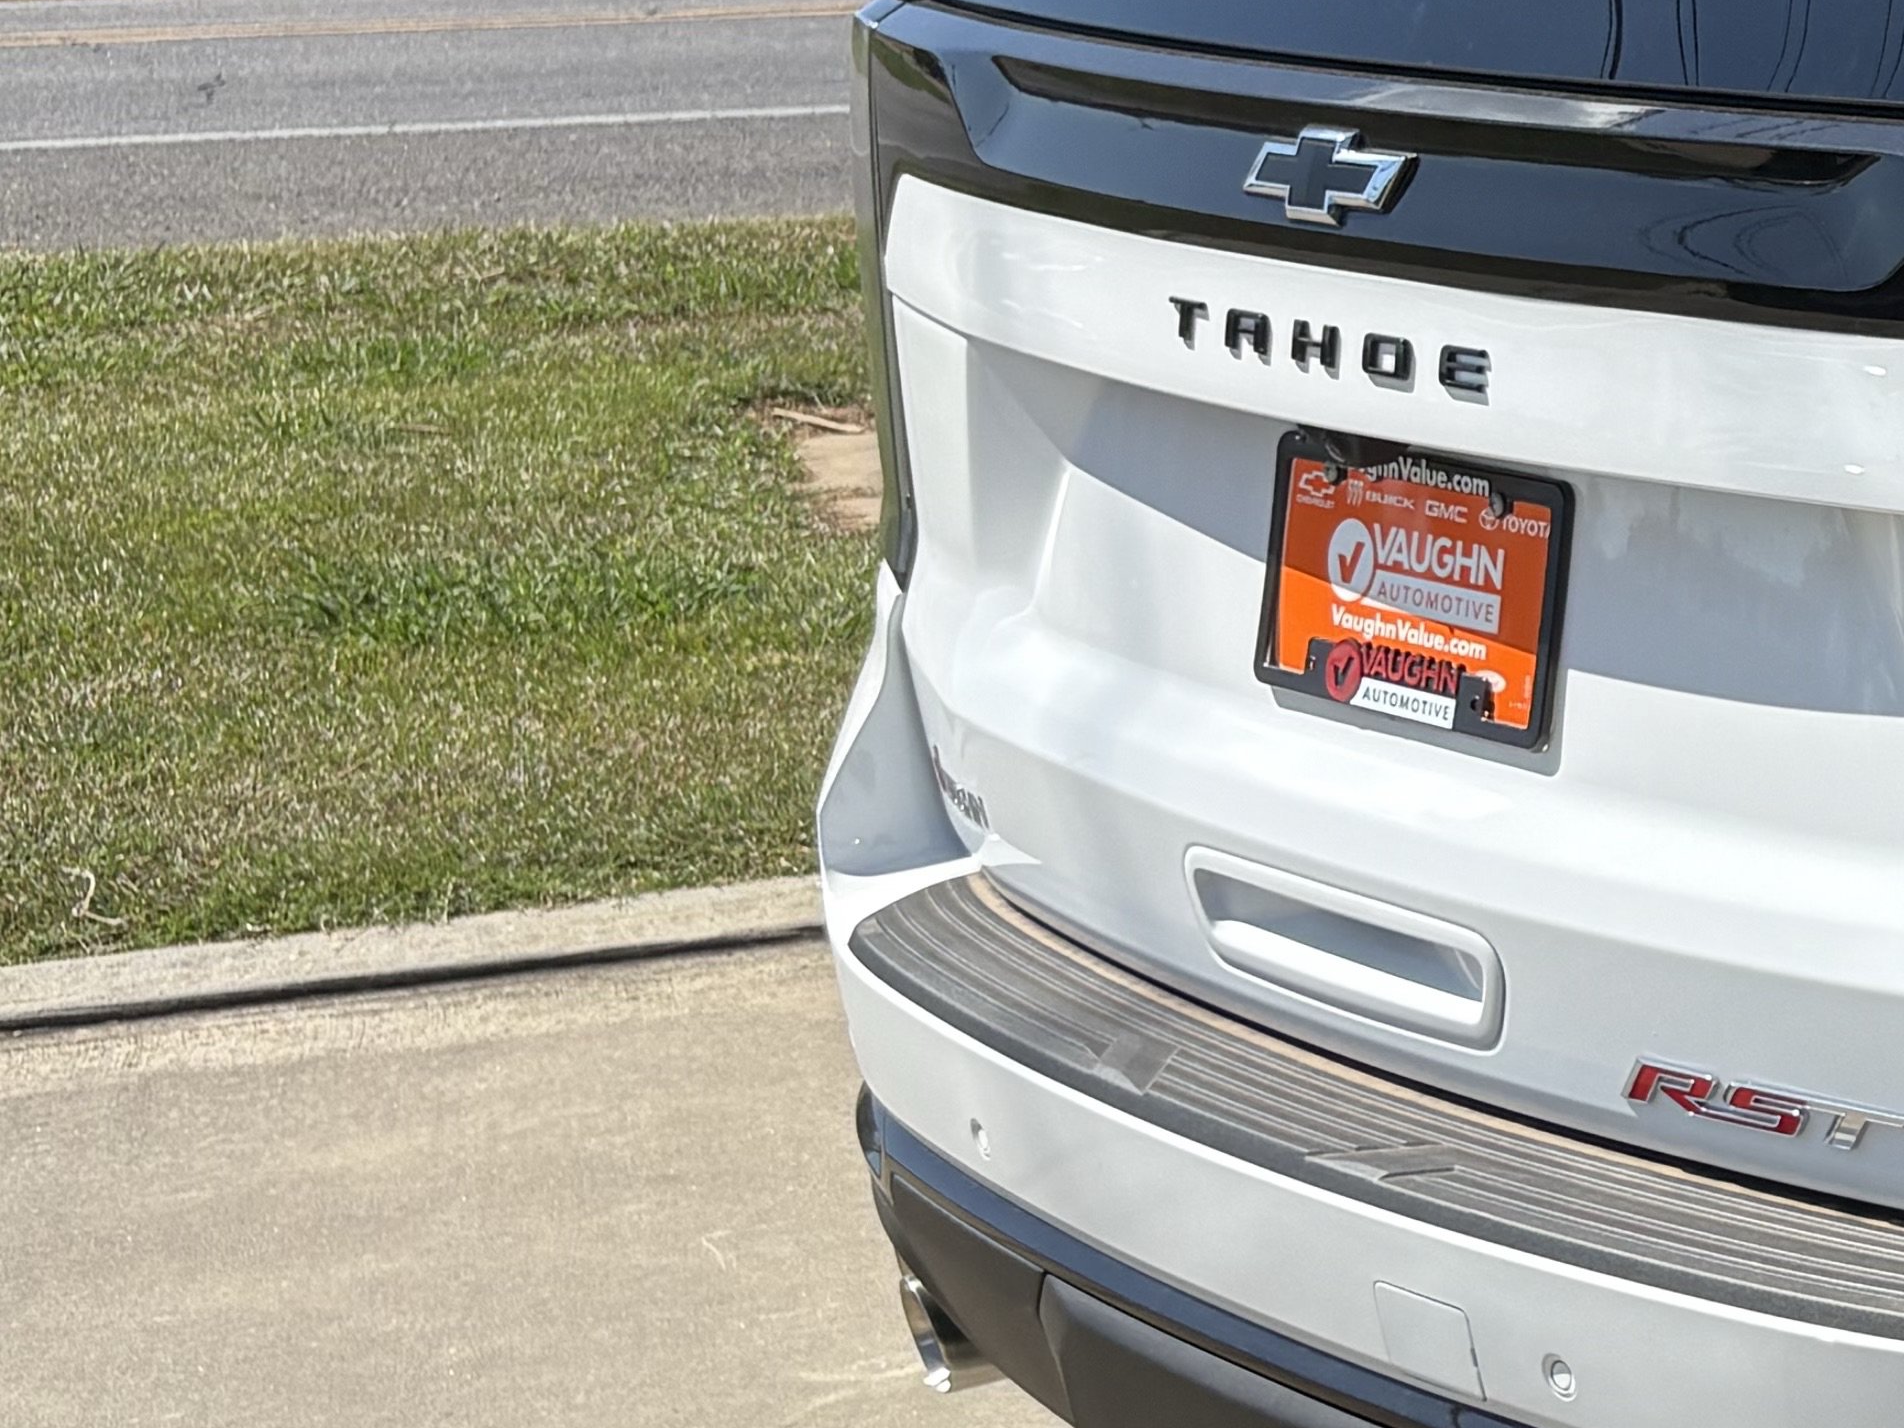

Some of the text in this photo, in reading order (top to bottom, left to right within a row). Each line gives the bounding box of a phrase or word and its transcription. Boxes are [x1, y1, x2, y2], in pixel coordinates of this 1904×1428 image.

[1168, 295, 1491, 394] TAHOE
[1365, 490, 1415, 510] BUICK
[1424, 499, 1469, 524] GMC
[1373, 522, 1505, 591] VAUGHN
[1378, 580, 1494, 623] AUTOMOTIVE
[1331, 604, 1488, 661] VaughnValue.com
[1361, 645, 1458, 695] VAUGHN
[1362, 686, 1451, 721] AUTOMOTIVE
